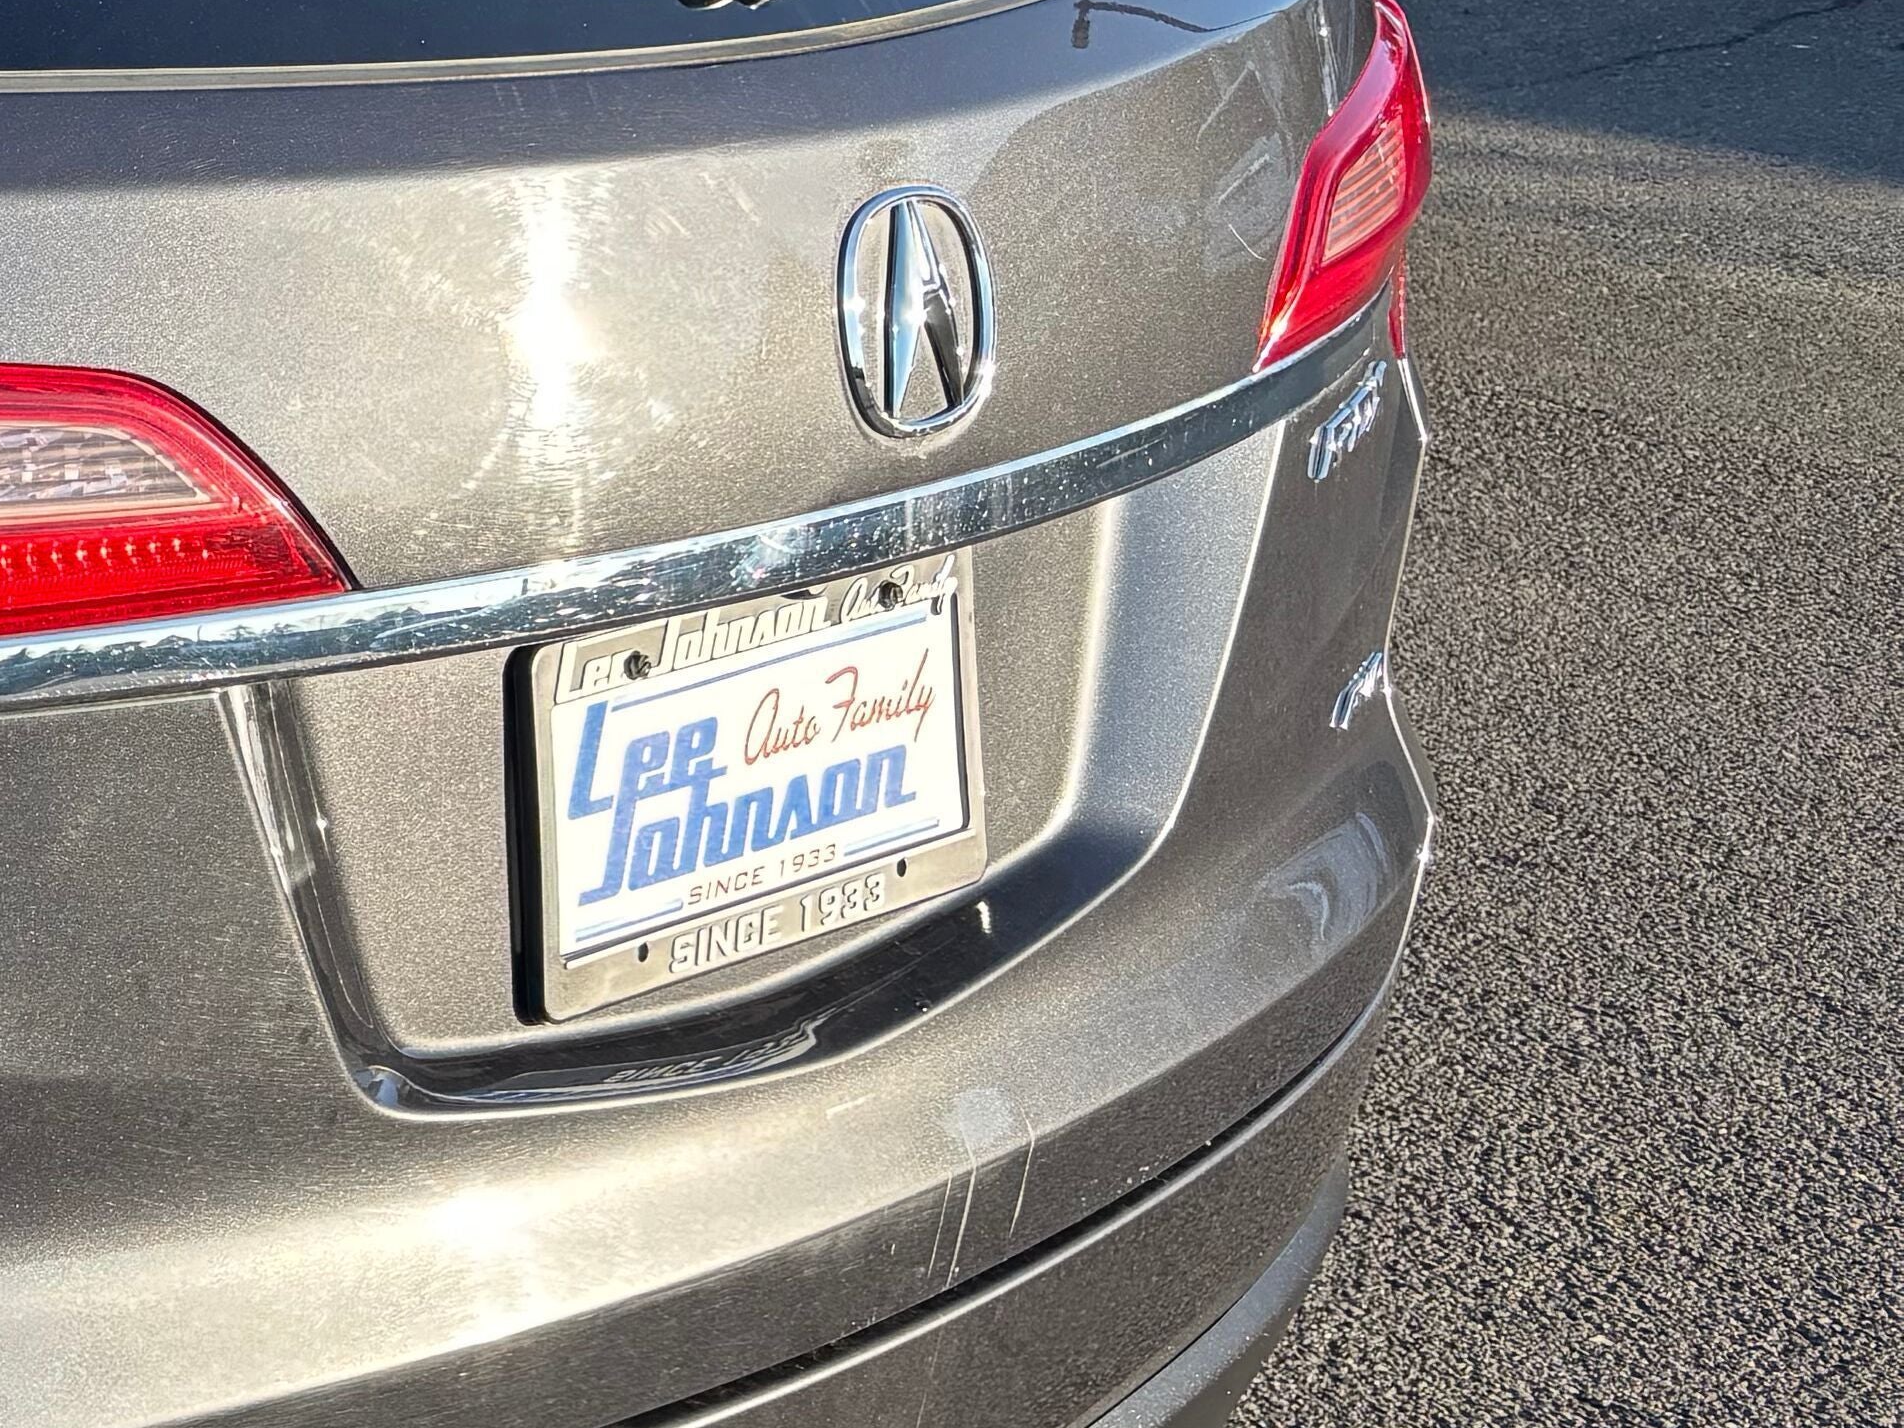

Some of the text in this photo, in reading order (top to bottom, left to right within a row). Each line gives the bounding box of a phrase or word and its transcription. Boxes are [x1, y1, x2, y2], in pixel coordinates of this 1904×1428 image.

[649, 595, 832, 676] Johnson
[567, 648, 936, 821] Lee Auto Family
[578, 744, 917, 907] Johnson
[687, 843, 838, 906] SINCE 1933
[668, 873, 888, 974] SINCE 1933
